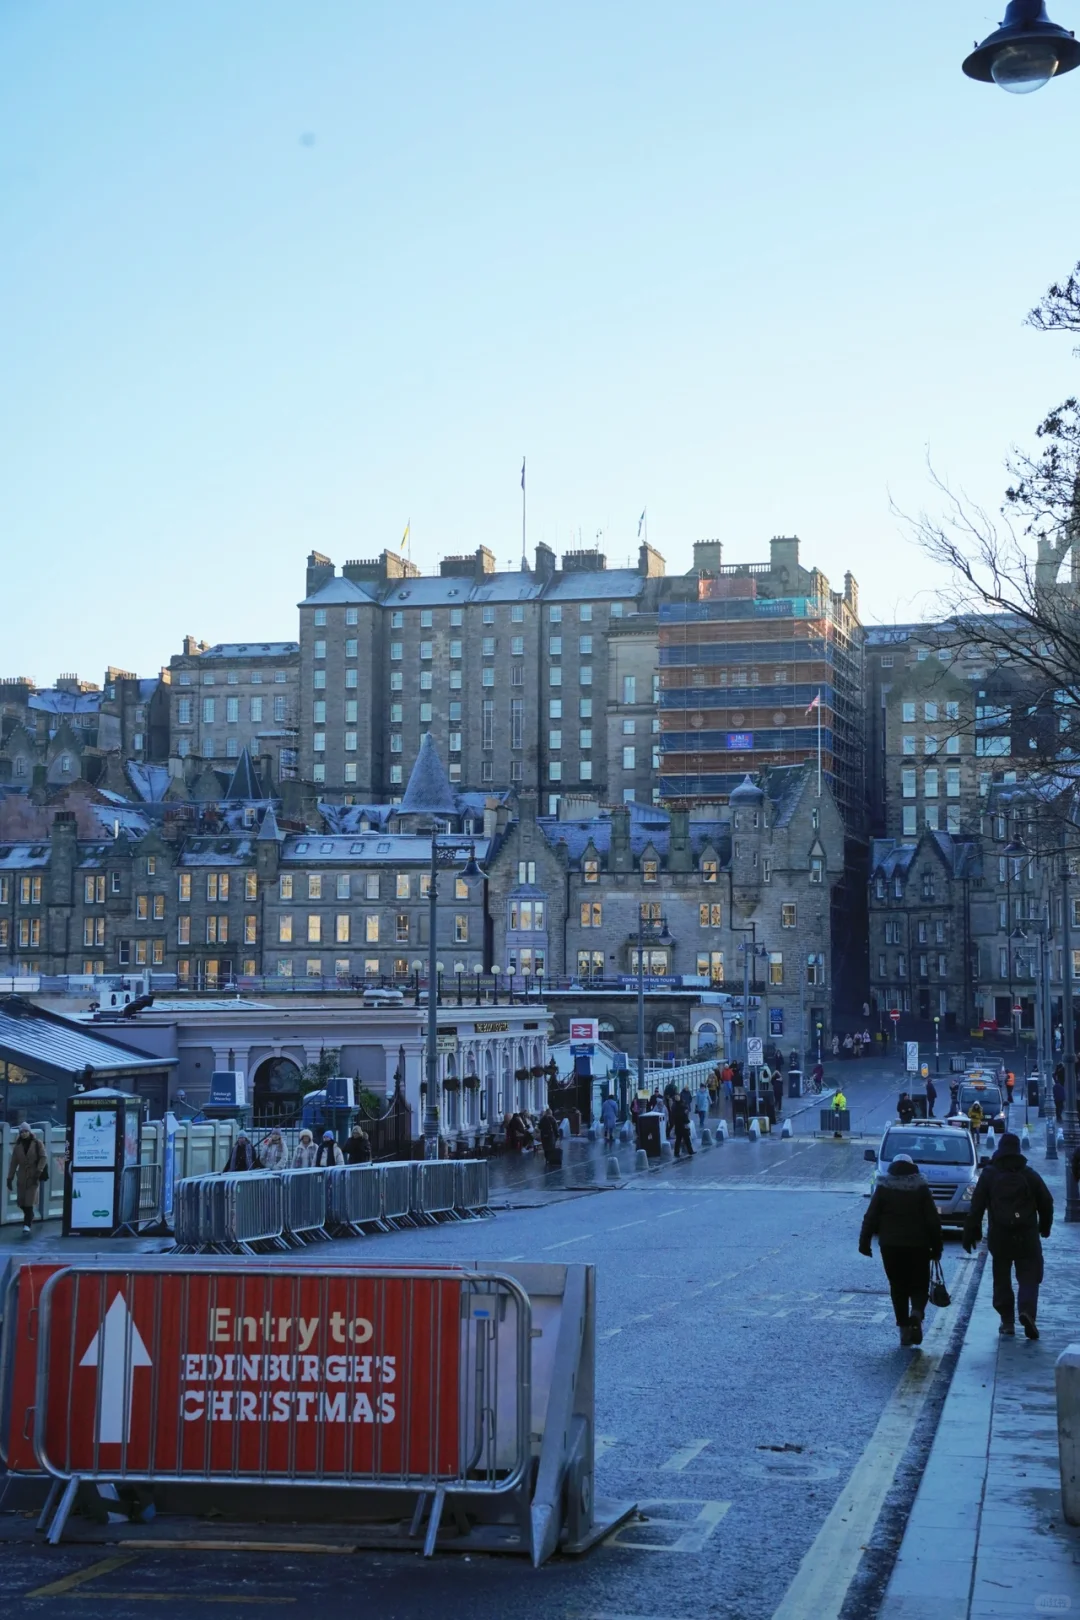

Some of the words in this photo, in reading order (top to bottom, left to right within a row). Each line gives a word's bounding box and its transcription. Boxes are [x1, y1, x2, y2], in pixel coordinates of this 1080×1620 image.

[209, 1307, 320, 1352] Entry
[329, 1311, 374, 1344] to
[180, 1353, 397, 1384] EDINBURGH'S
[179, 1389, 397, 1425] CHRISTMAS
